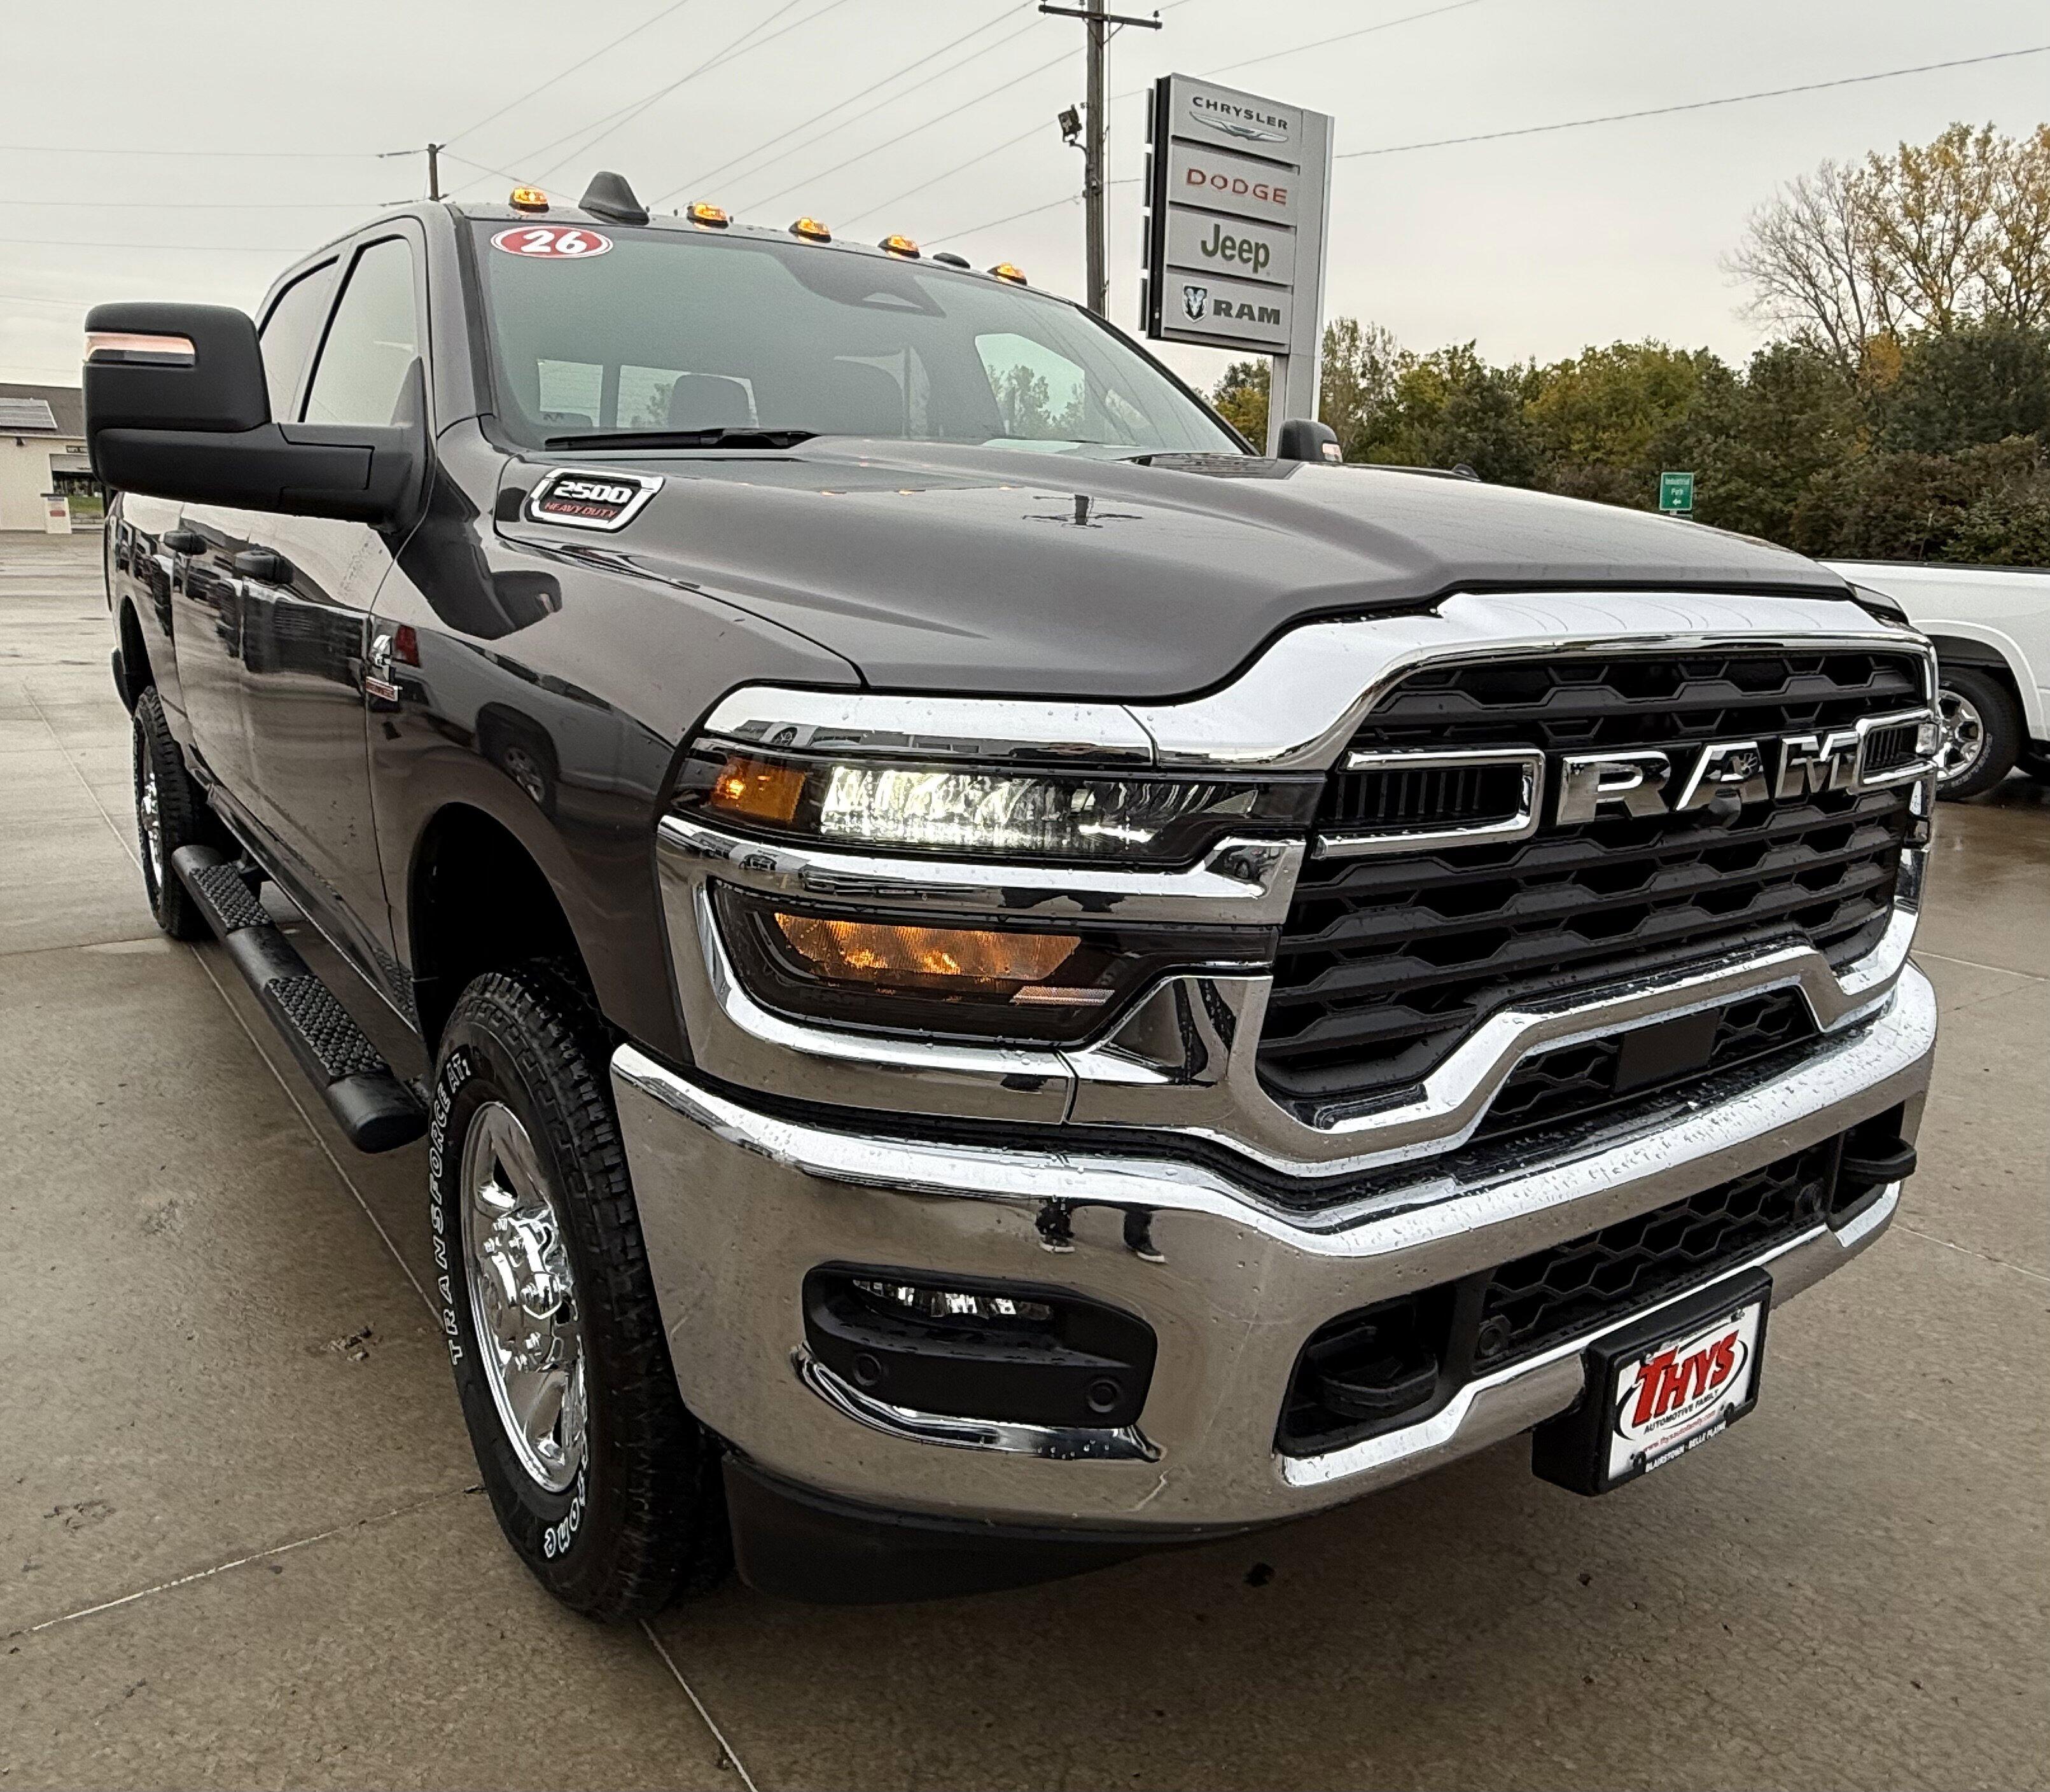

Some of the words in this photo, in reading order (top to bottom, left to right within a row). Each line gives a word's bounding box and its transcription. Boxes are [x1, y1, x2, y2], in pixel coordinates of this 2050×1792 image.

[1192, 95, 1288, 130] CHRYSLER
[1186, 167, 1288, 206] DODGE
[520, 229, 588, 254] 26
[1201, 223, 1271, 274] Jeep
[1213, 298, 1281, 326] RAM
[545, 501, 582, 513] HEAVY
[582, 506, 617, 518] DUTY
[554, 480, 633, 504] 2500
[1556, 730, 1860, 826] RAM
[429, 1082, 463, 1366] TRANSFORCE
[1631, 1330, 1740, 1428] THYS
[1643, 1403, 1694, 1435] AUTOMOTIVE
